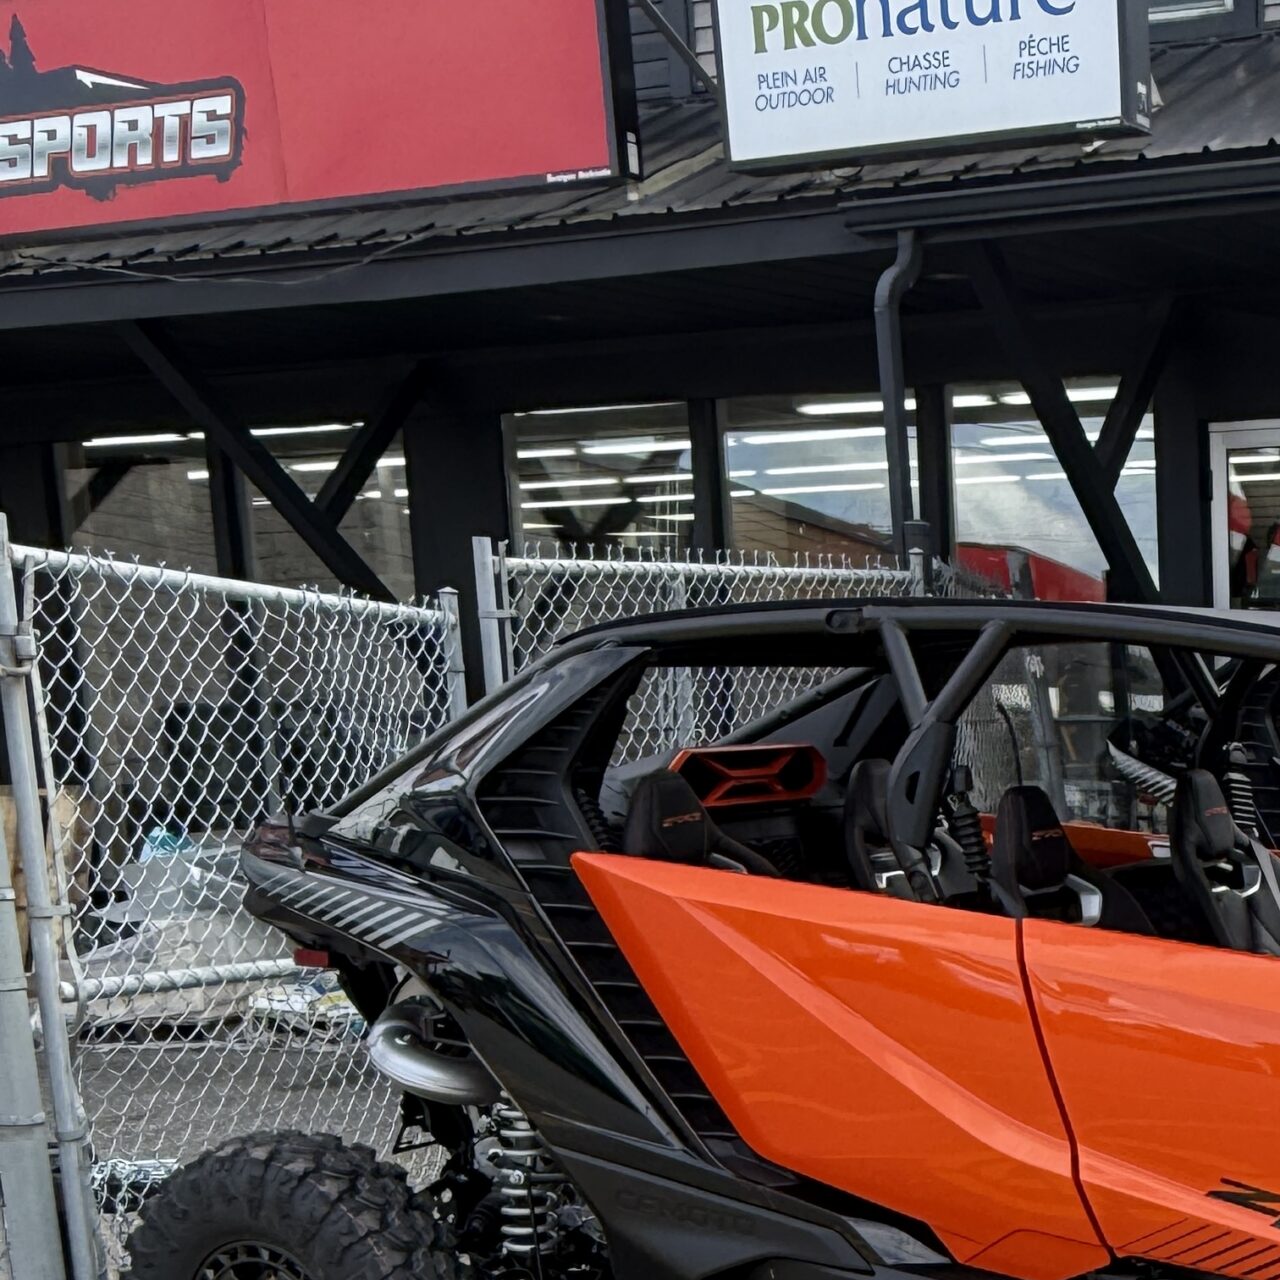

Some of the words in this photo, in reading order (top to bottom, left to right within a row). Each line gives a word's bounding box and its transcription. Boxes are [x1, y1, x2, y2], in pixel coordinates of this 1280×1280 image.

[887, 50, 951, 74] CHASSE
[1012, 55, 1080, 80] FISHING
[757, 69, 798, 91] PLEIN
[802, 66, 828, 86] AIR
[885, 70, 960, 96] HUNTING
[754, 86, 835, 112] OUTDOOR
[0, 95, 232, 181] SPORTS
